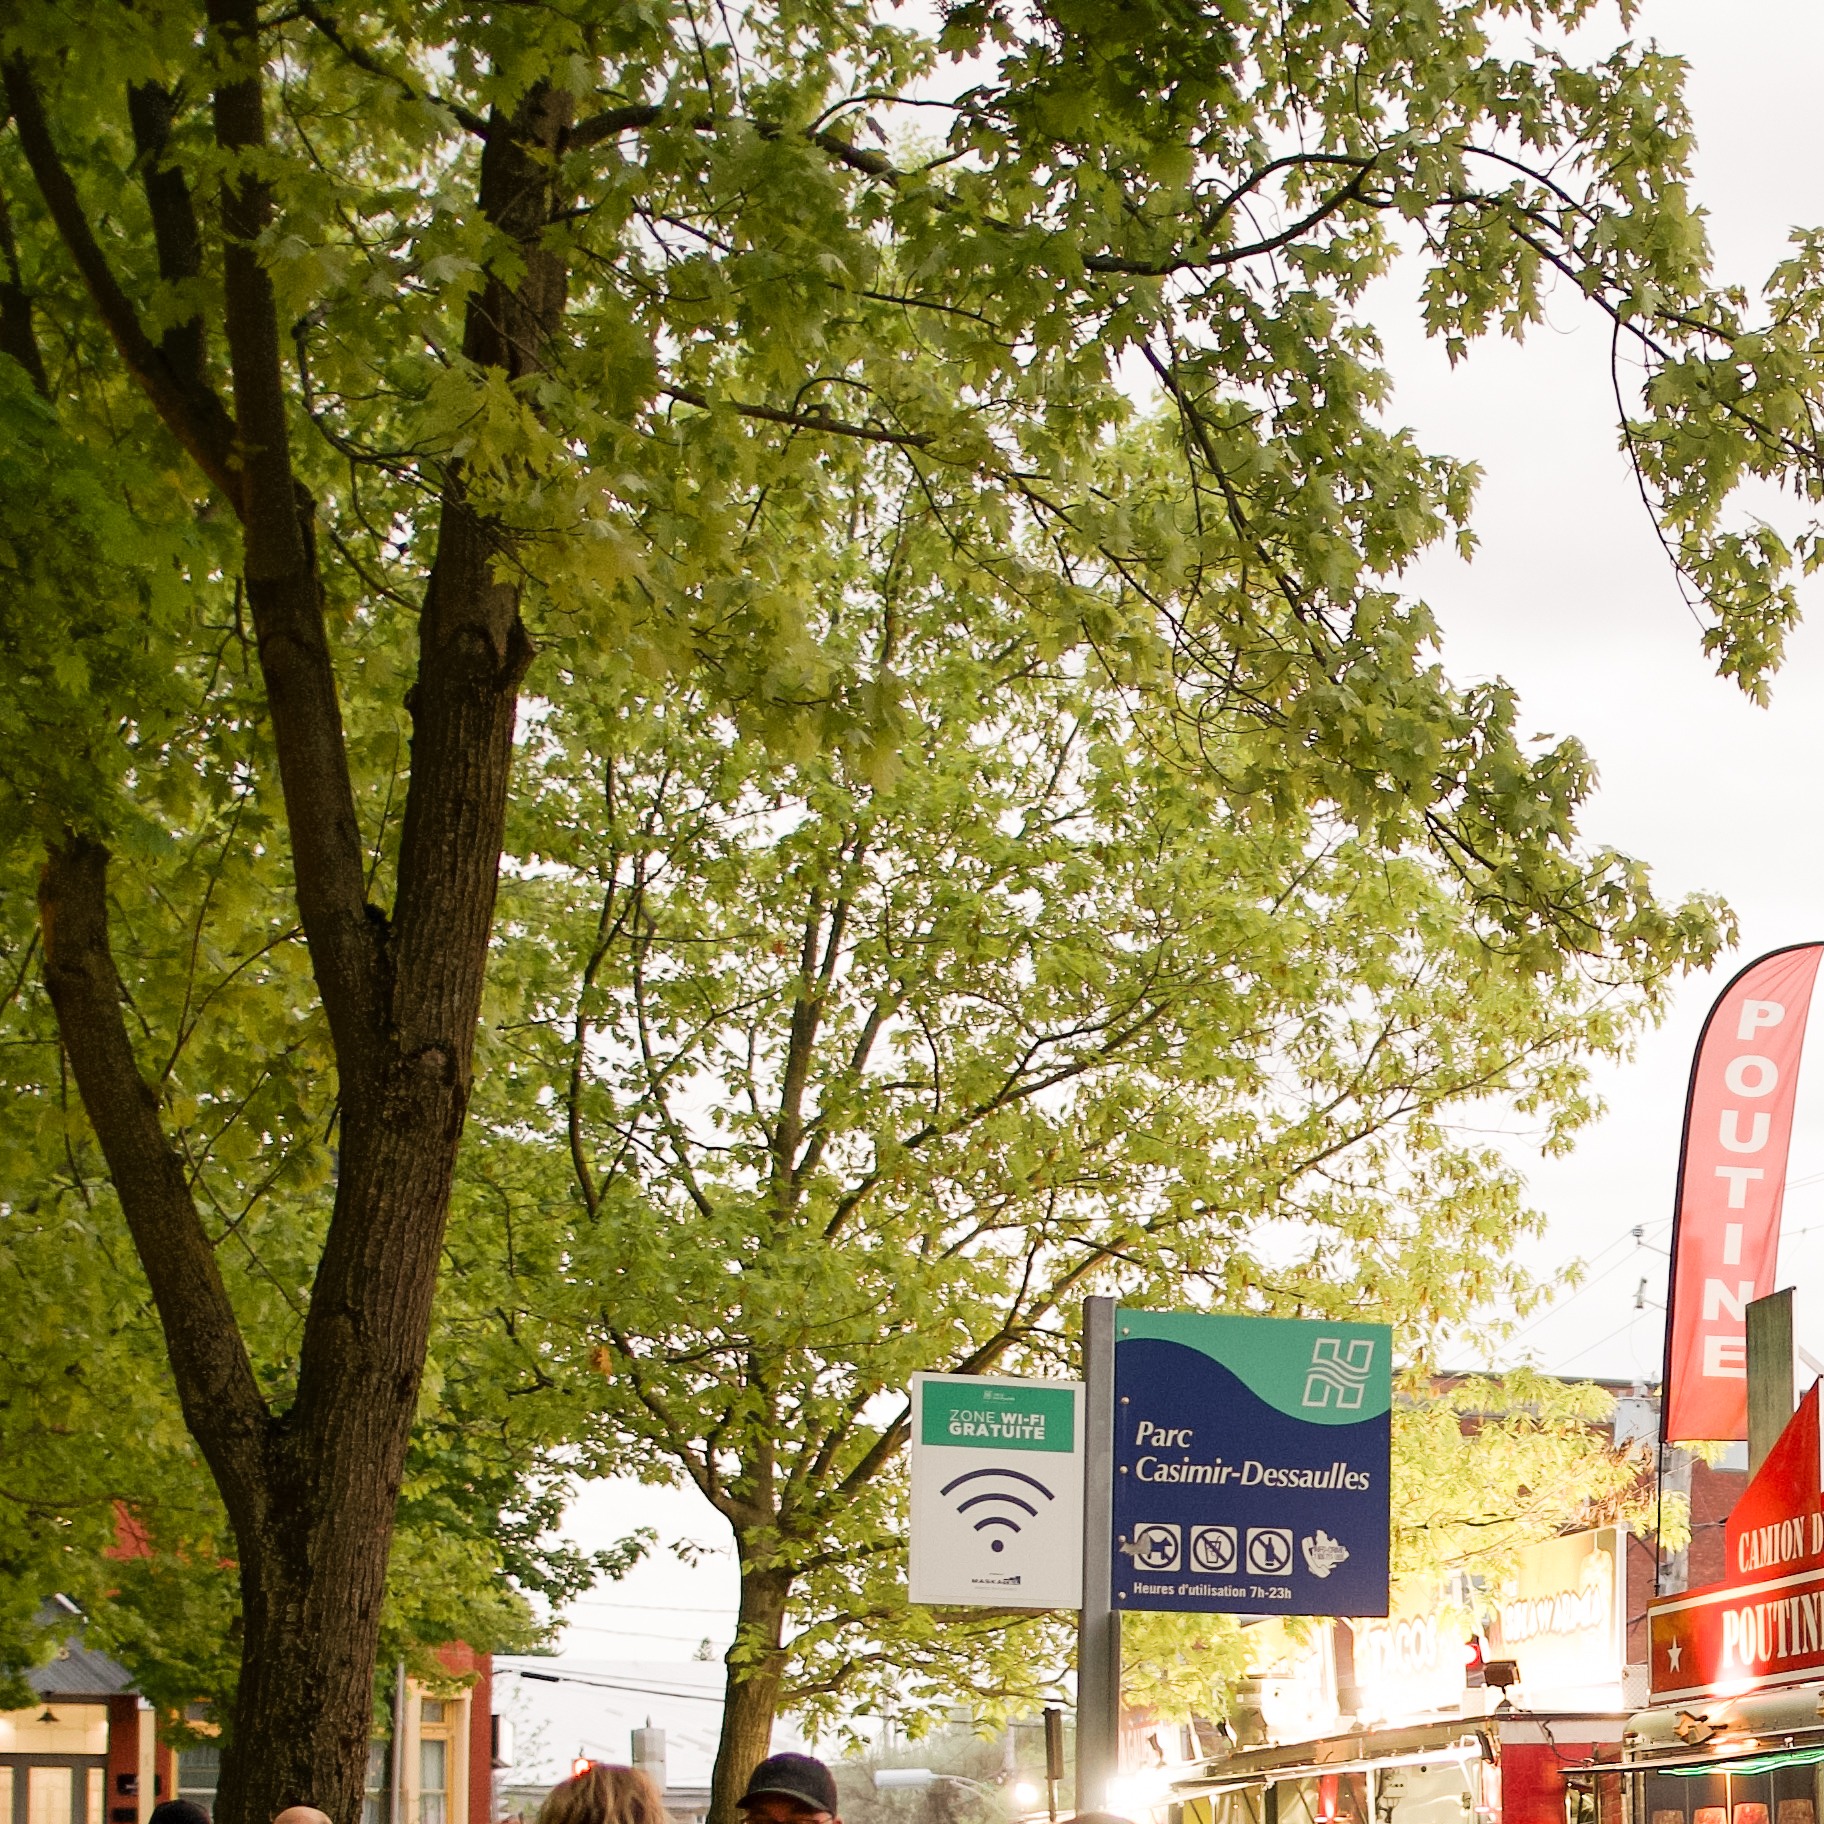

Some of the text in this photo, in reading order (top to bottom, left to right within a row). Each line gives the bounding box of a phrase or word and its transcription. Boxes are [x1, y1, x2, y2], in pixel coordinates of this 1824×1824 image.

[1702, 998, 1786, 1379] POUTINE
[949, 1409, 1045, 1426] ZONE WI-FI
[949, 1422, 1045, 1440] GRATUITE
[1136, 1421, 1193, 1447] Parc
[1135, 1456, 1371, 1490] Casimir-Dessaulles
[1738, 1515, 1805, 1573] CAMION
[1133, 1582, 1292, 1599] Heures d'utilisation 7h-23h
